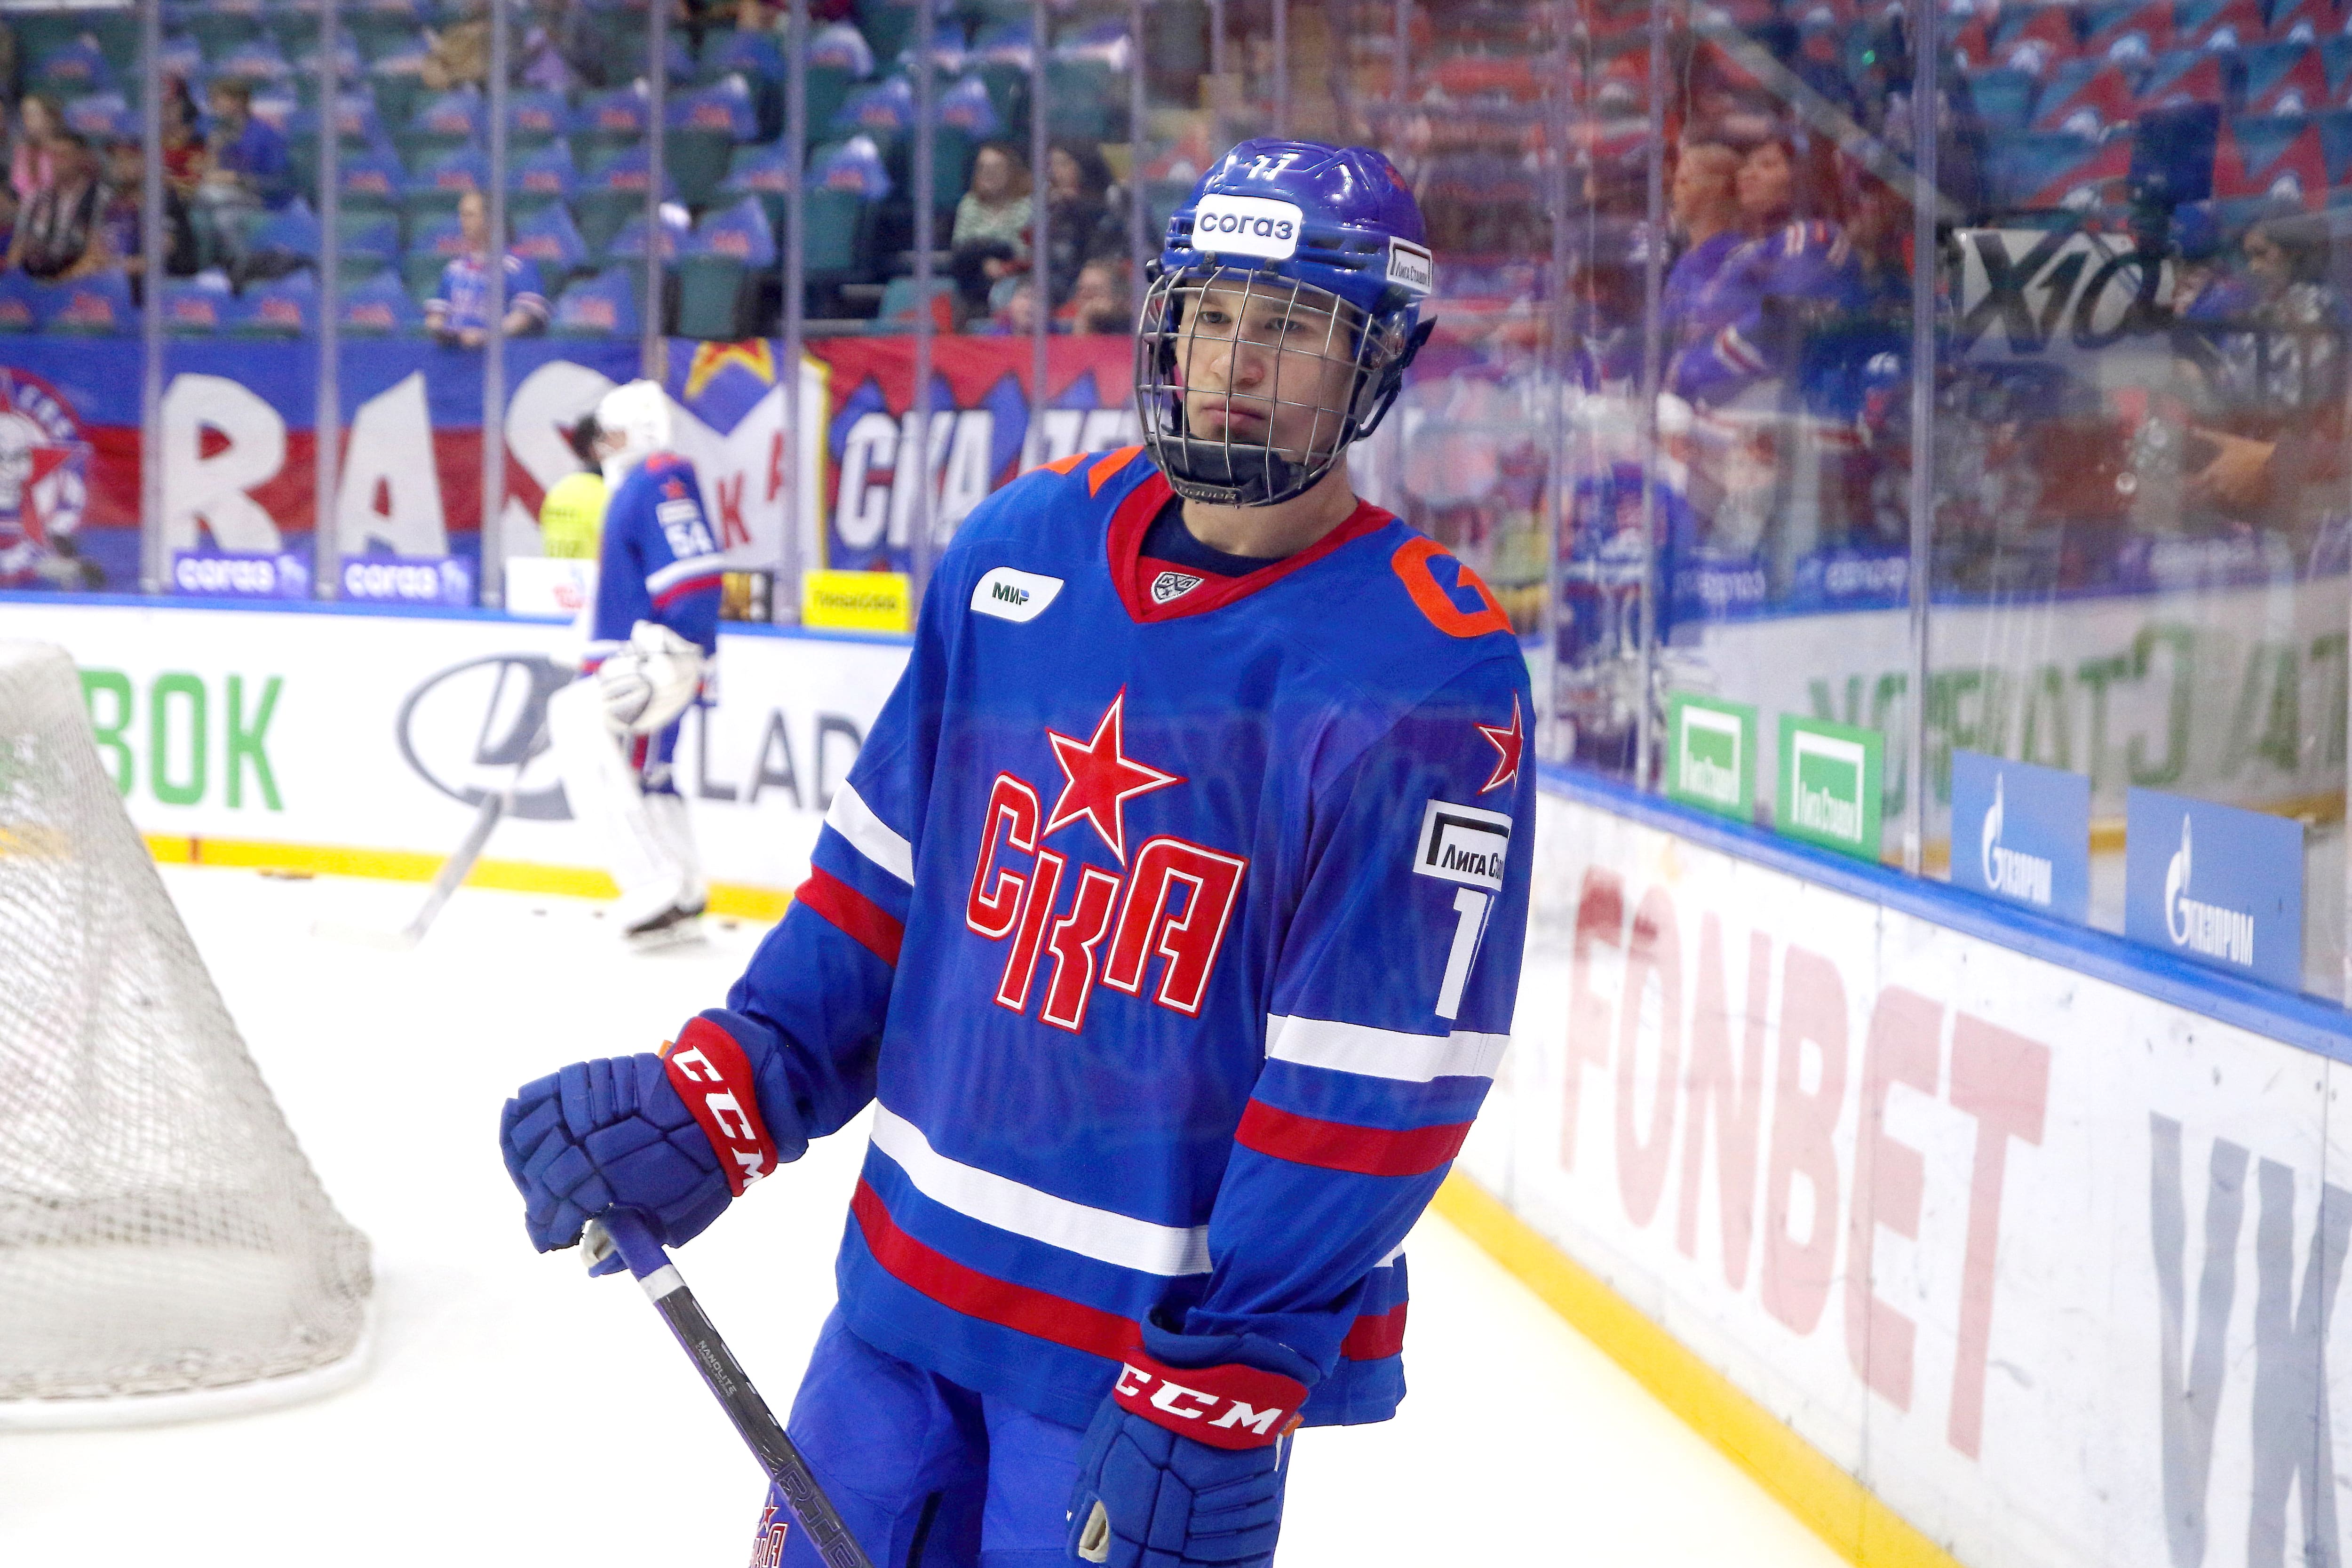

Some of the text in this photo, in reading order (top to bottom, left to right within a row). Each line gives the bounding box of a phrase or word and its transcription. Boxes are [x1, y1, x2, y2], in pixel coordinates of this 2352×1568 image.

[1200, 212, 1293, 239] согаз
[966, 771, 1250, 1035] СКА
[672, 1045, 765, 1187] CCM
[1559, 865, 2051, 1463] FONBET
[698, 1339, 737, 1395] NANOLITE
[1115, 1361, 1282, 1434] CCM
